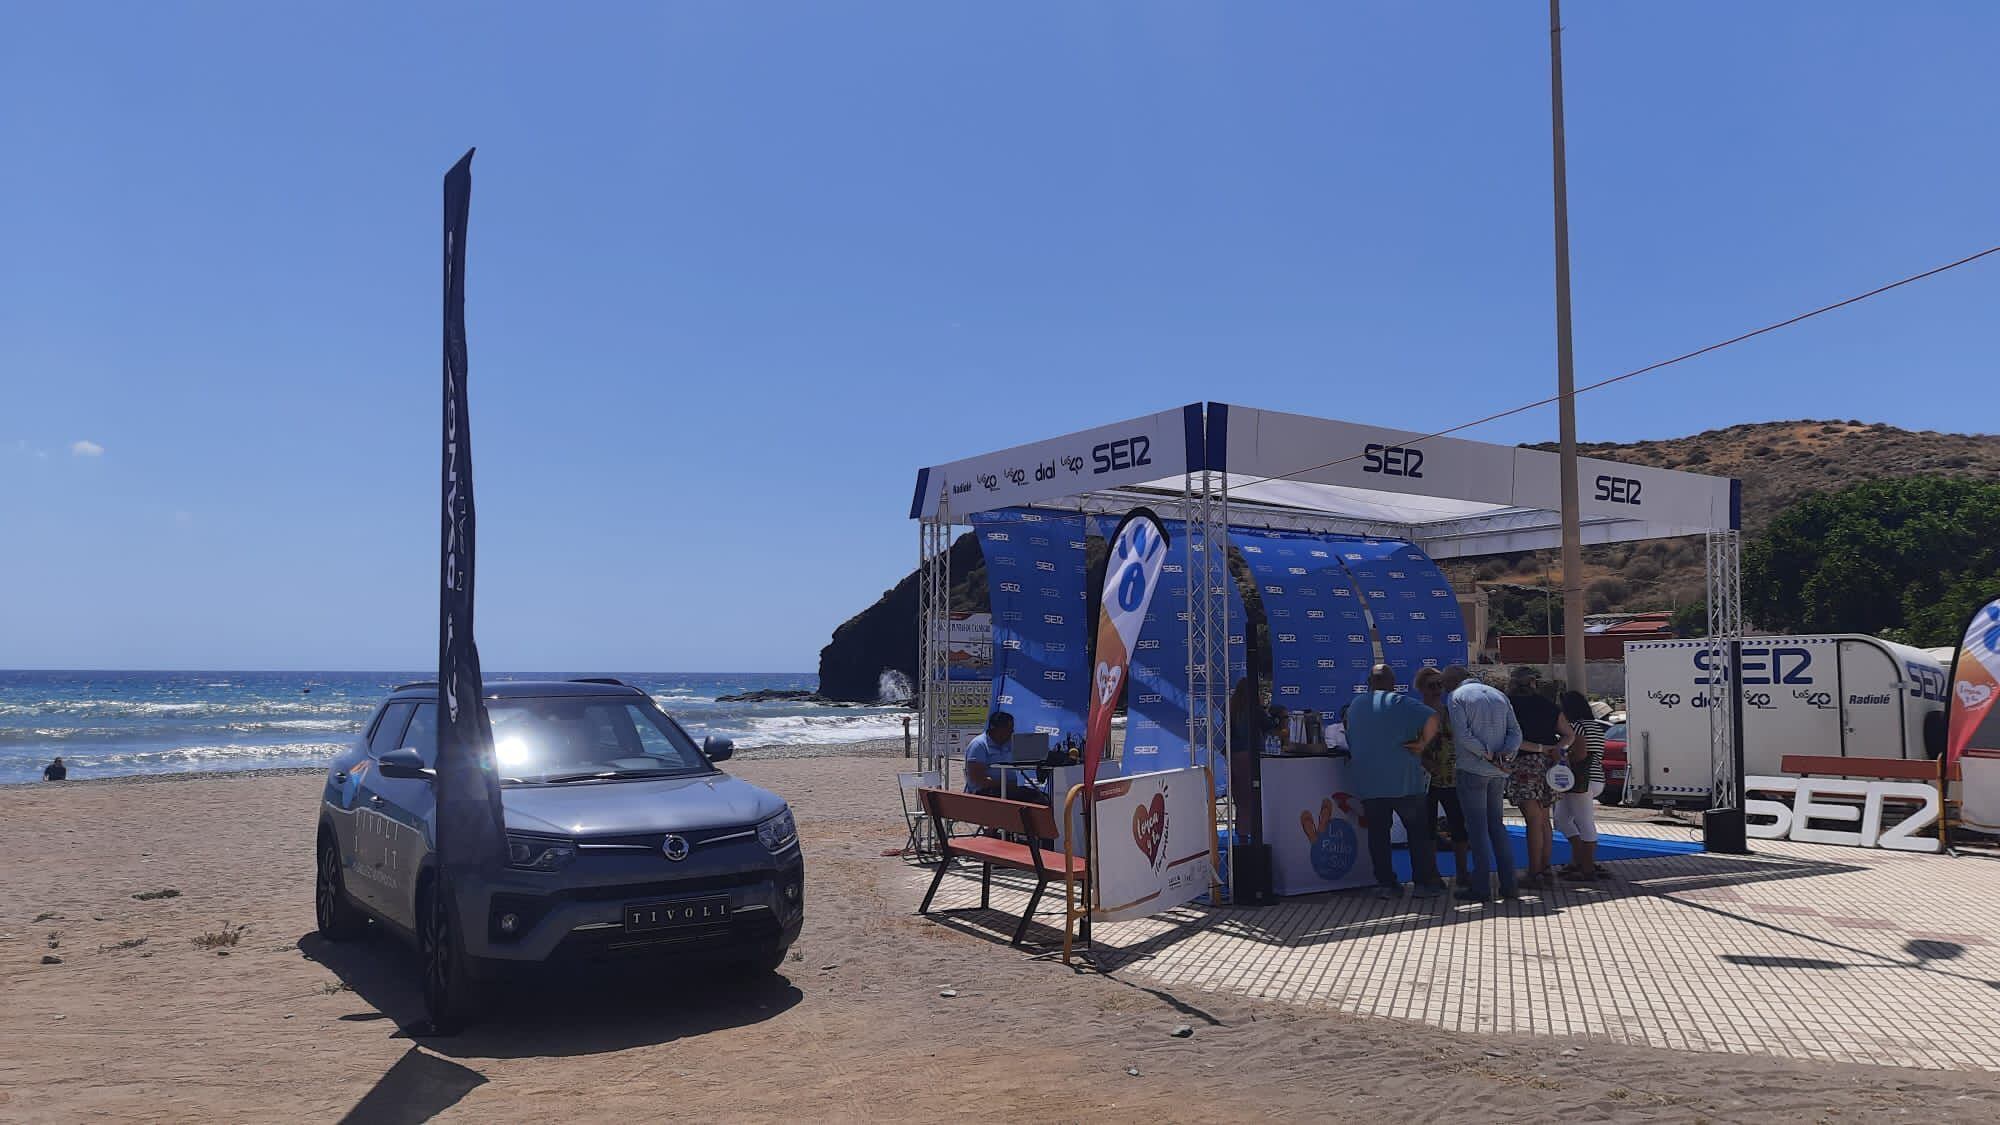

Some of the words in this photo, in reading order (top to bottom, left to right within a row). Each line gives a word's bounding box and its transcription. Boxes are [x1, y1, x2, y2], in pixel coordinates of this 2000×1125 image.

[1035, 459, 1056, 482] dial
[1092, 435, 1152, 475] SER
[1362, 443, 1424, 479] SER
[1594, 475, 1642, 505] SER
[1849, 693, 1891, 705] Radiolé
[1906, 660, 1948, 703] SER
[1745, 776, 1940, 852] SER
[632, 904, 727, 924] TIVOLI
